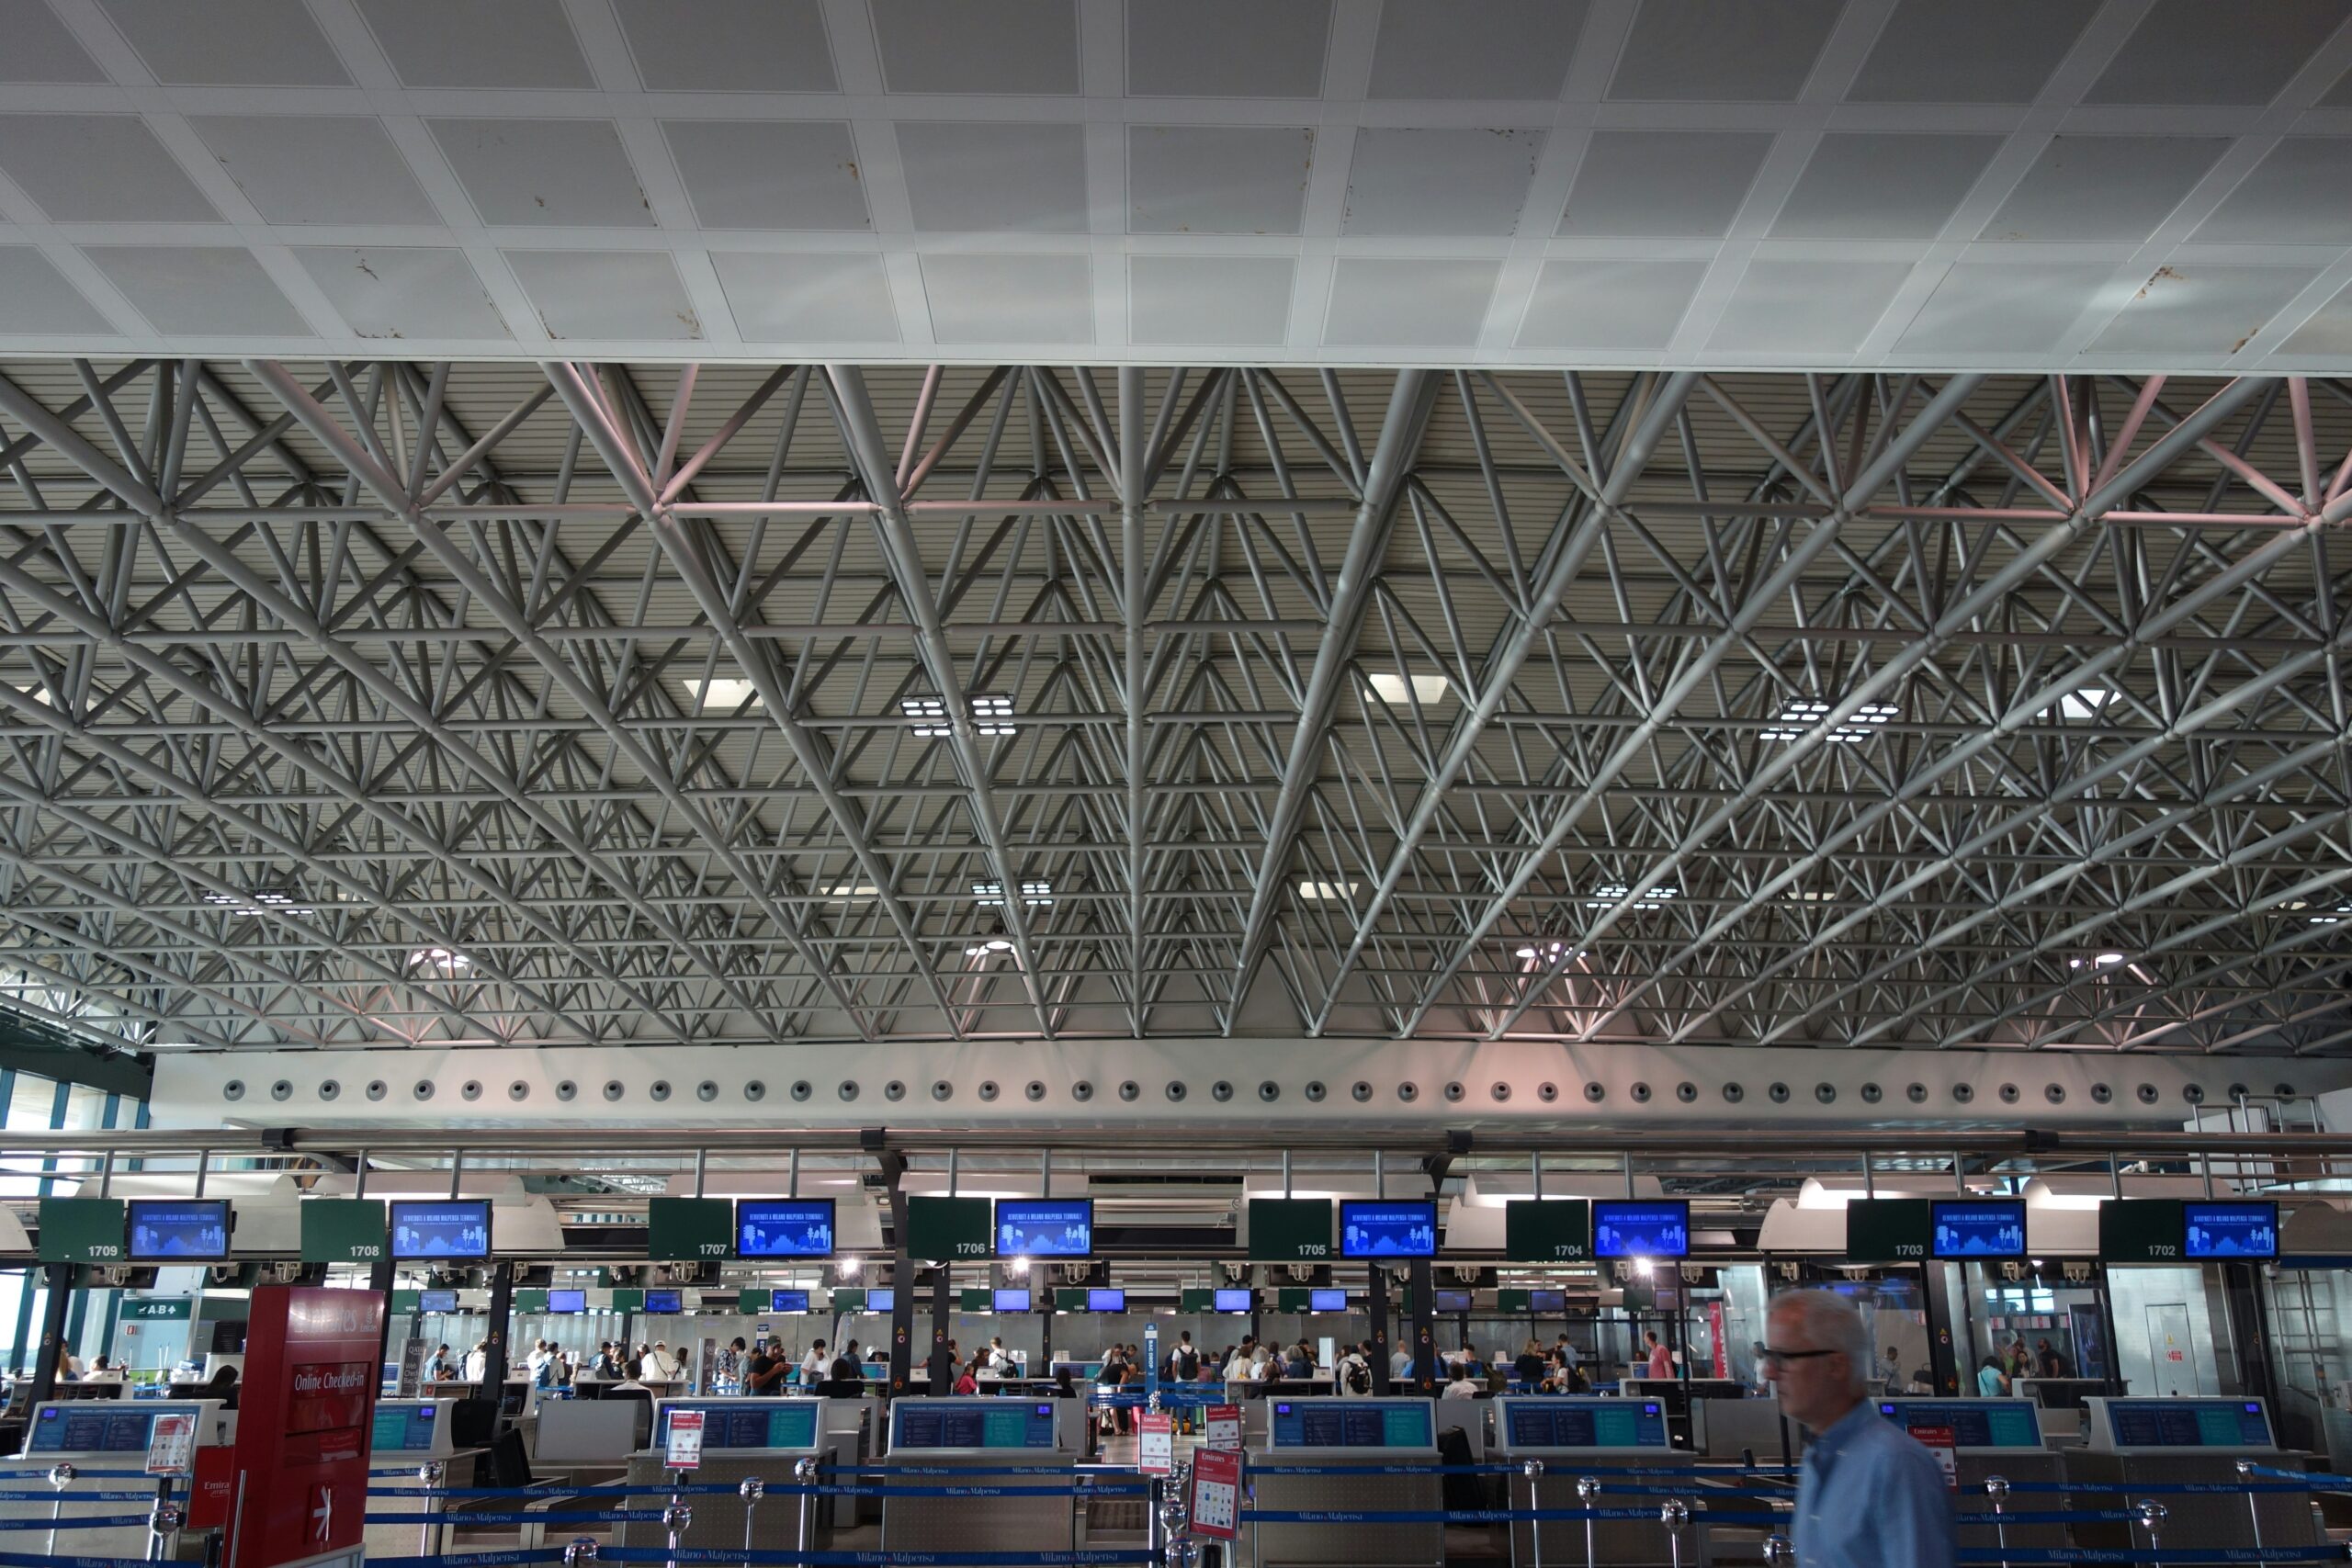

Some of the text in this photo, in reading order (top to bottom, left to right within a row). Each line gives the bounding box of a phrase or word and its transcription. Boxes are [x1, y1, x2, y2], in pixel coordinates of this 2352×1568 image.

[88, 1246, 118, 1257] 1709
[350, 1246, 379, 1257] 1708
[699, 1244, 727, 1255] 1707
[956, 1243, 986, 1254] 1706
[1297, 1245, 1326, 1256] 1705
[1555, 1245, 1583, 1256] 1704
[1895, 1245, 1923, 1256] 1703
[2148, 1245, 2176, 1256] 1702
[295, 1371, 364, 1391] Online Checked-in
[1202, 1452, 1225, 1463] Emirates
[548, 1488, 579, 1496] Malpensa
[842, 1486, 873, 1495] Malpensa
[970, 1487, 1001, 1495] Malpensa
[1097, 1486, 1126, 1495] Malpensa
[447, 1513, 511, 1523] Milano Malpensa
[598, 1512, 624, 1520] Milano
[1329, 1513, 1363, 1521] Malpensa
[1478, 1511, 1513, 1520] Malpensa
[443, 1553, 519, 1565] Milano Malpensa
[672, 1550, 750, 1560] Milano Malpensa
[855, 1552, 934, 1563] Milano Malpensa
[1040, 1552, 1117, 1562] Milano Malpensa
[2048, 1551, 2124, 1562] Milano Malpensa
[2225, 1550, 2301, 1559] Milano Malpensa
